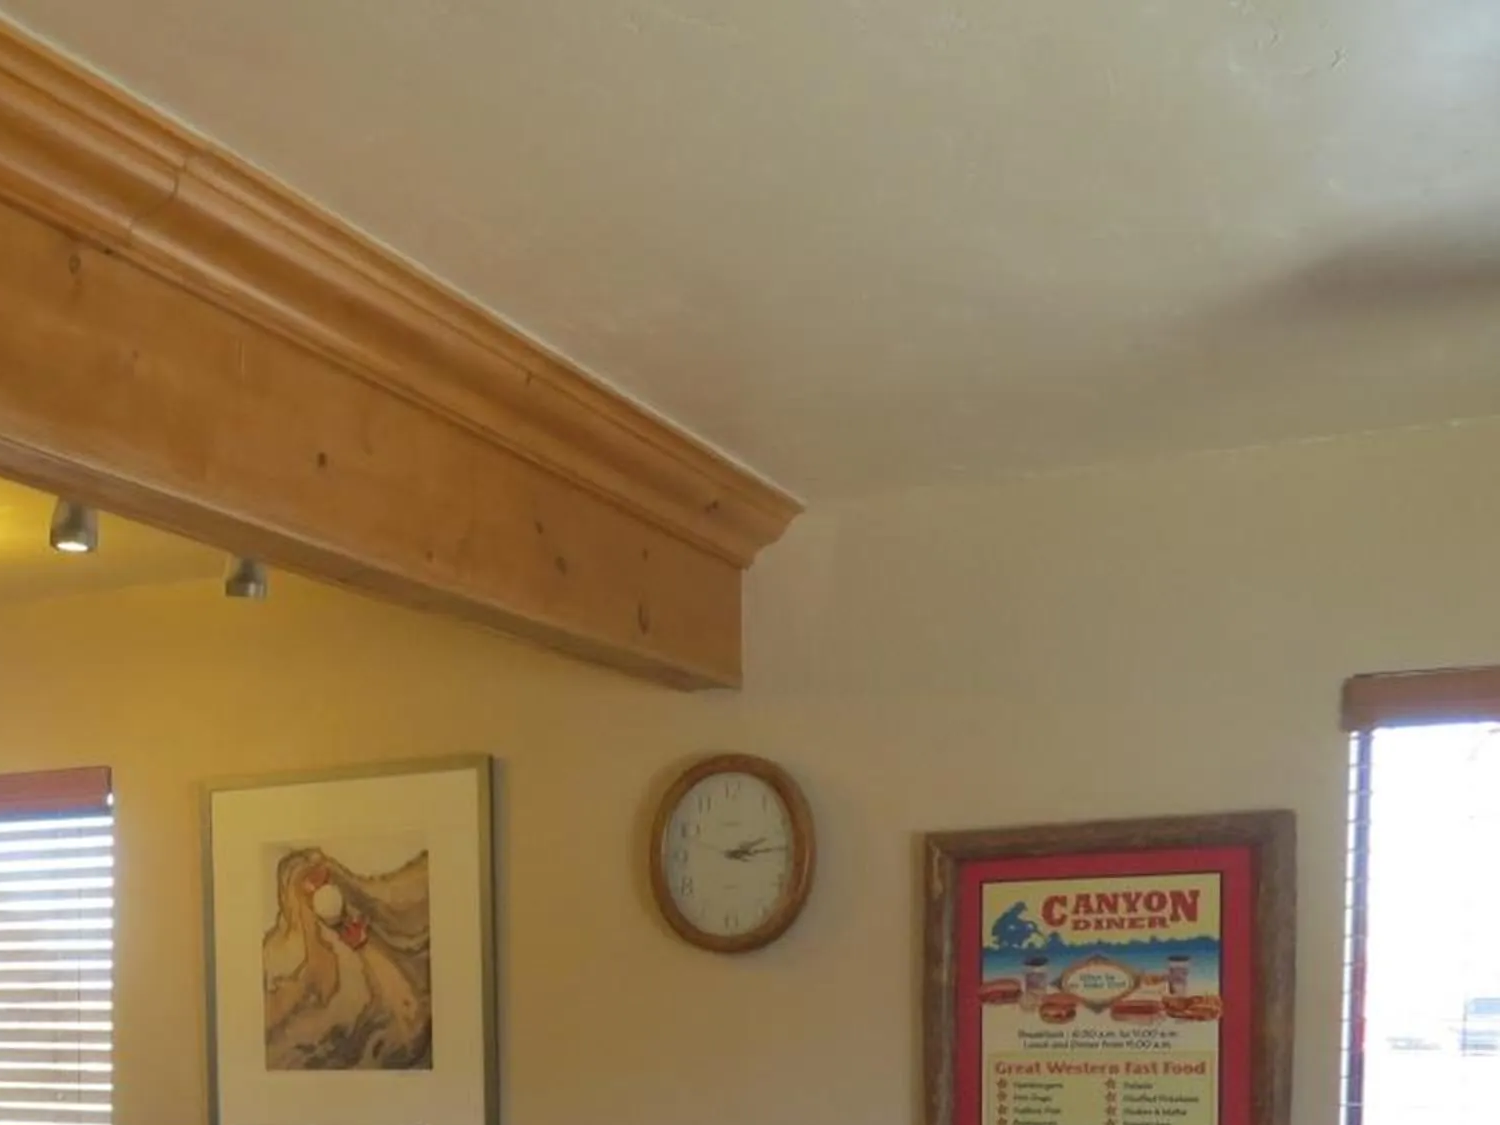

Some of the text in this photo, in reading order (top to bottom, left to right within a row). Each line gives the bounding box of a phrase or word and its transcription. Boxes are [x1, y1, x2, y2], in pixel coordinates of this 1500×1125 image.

[1041, 889, 1200, 928] CANYON
[1071, 917, 1169, 931] DINER
[995, 1060, 1206, 1075] Great Western Fast Food
